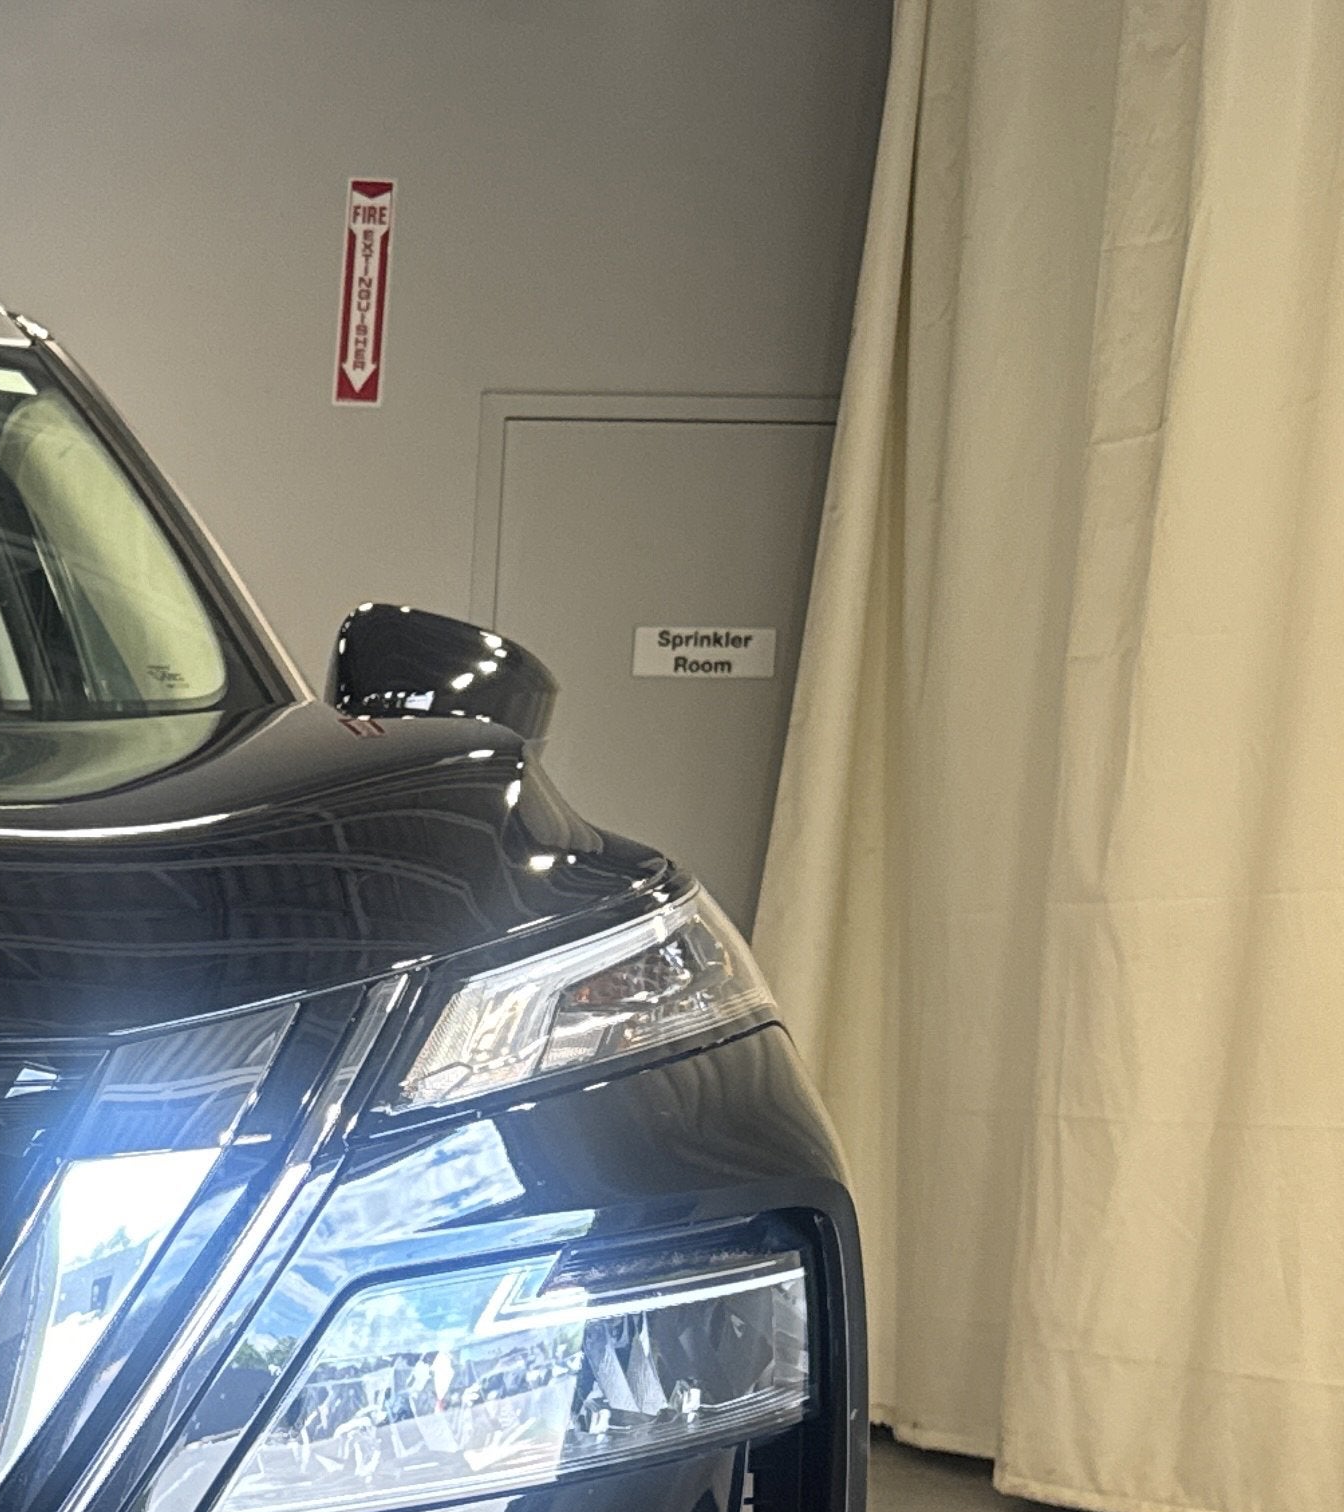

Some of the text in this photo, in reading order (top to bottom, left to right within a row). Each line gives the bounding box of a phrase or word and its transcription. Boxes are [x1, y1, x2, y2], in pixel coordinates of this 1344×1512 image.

[352, 205, 388, 226] FIRE
[352, 229, 375, 372] EXTINGUISHER
[657, 629, 753, 651] Sprinkler
[673, 655, 733, 674] Room
